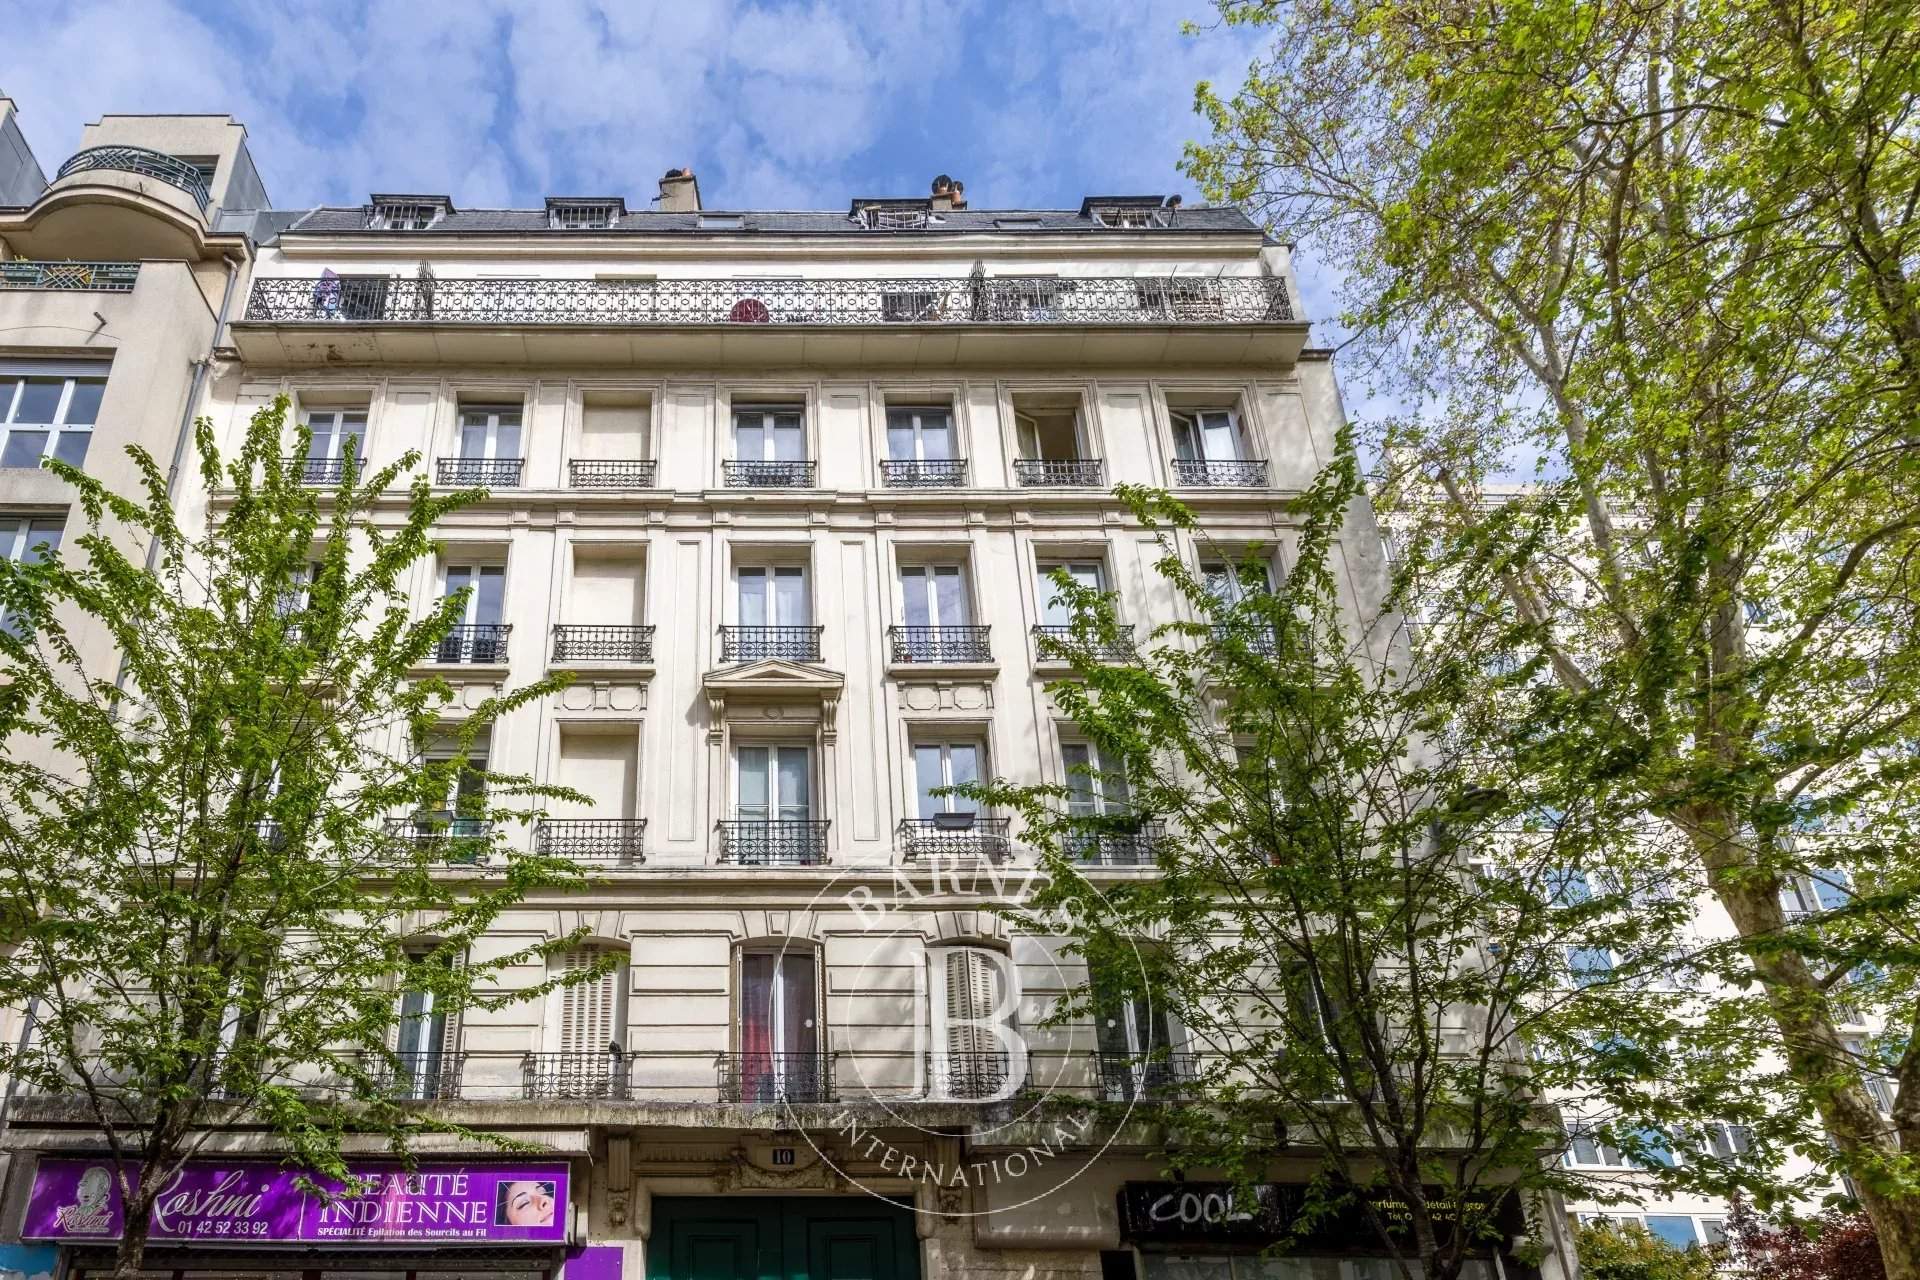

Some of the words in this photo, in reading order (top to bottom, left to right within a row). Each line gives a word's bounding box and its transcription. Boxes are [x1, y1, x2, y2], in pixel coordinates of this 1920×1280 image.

[776, 1150, 791, 1164] 10
[319, 1201, 488, 1224] INDIENNE
[1150, 1193, 1253, 1222] COOL
[177, 1221, 192, 1234] 01
[196, 1221, 212, 1234] 42
[215, 1221, 231, 1234] 52
[234, 1222, 249, 1234] 33
[252, 1222, 269, 1234] 92
[317, 1226, 366, 1236] SPÉCIALITÉ
[368, 1228, 405, 1238] Epilation
[408, 1228, 423, 1236] des
[425, 1228, 460, 1237] Sourcils
[462, 1229, 473, 1237] au
[475, 1228, 487, 1237] Fil
